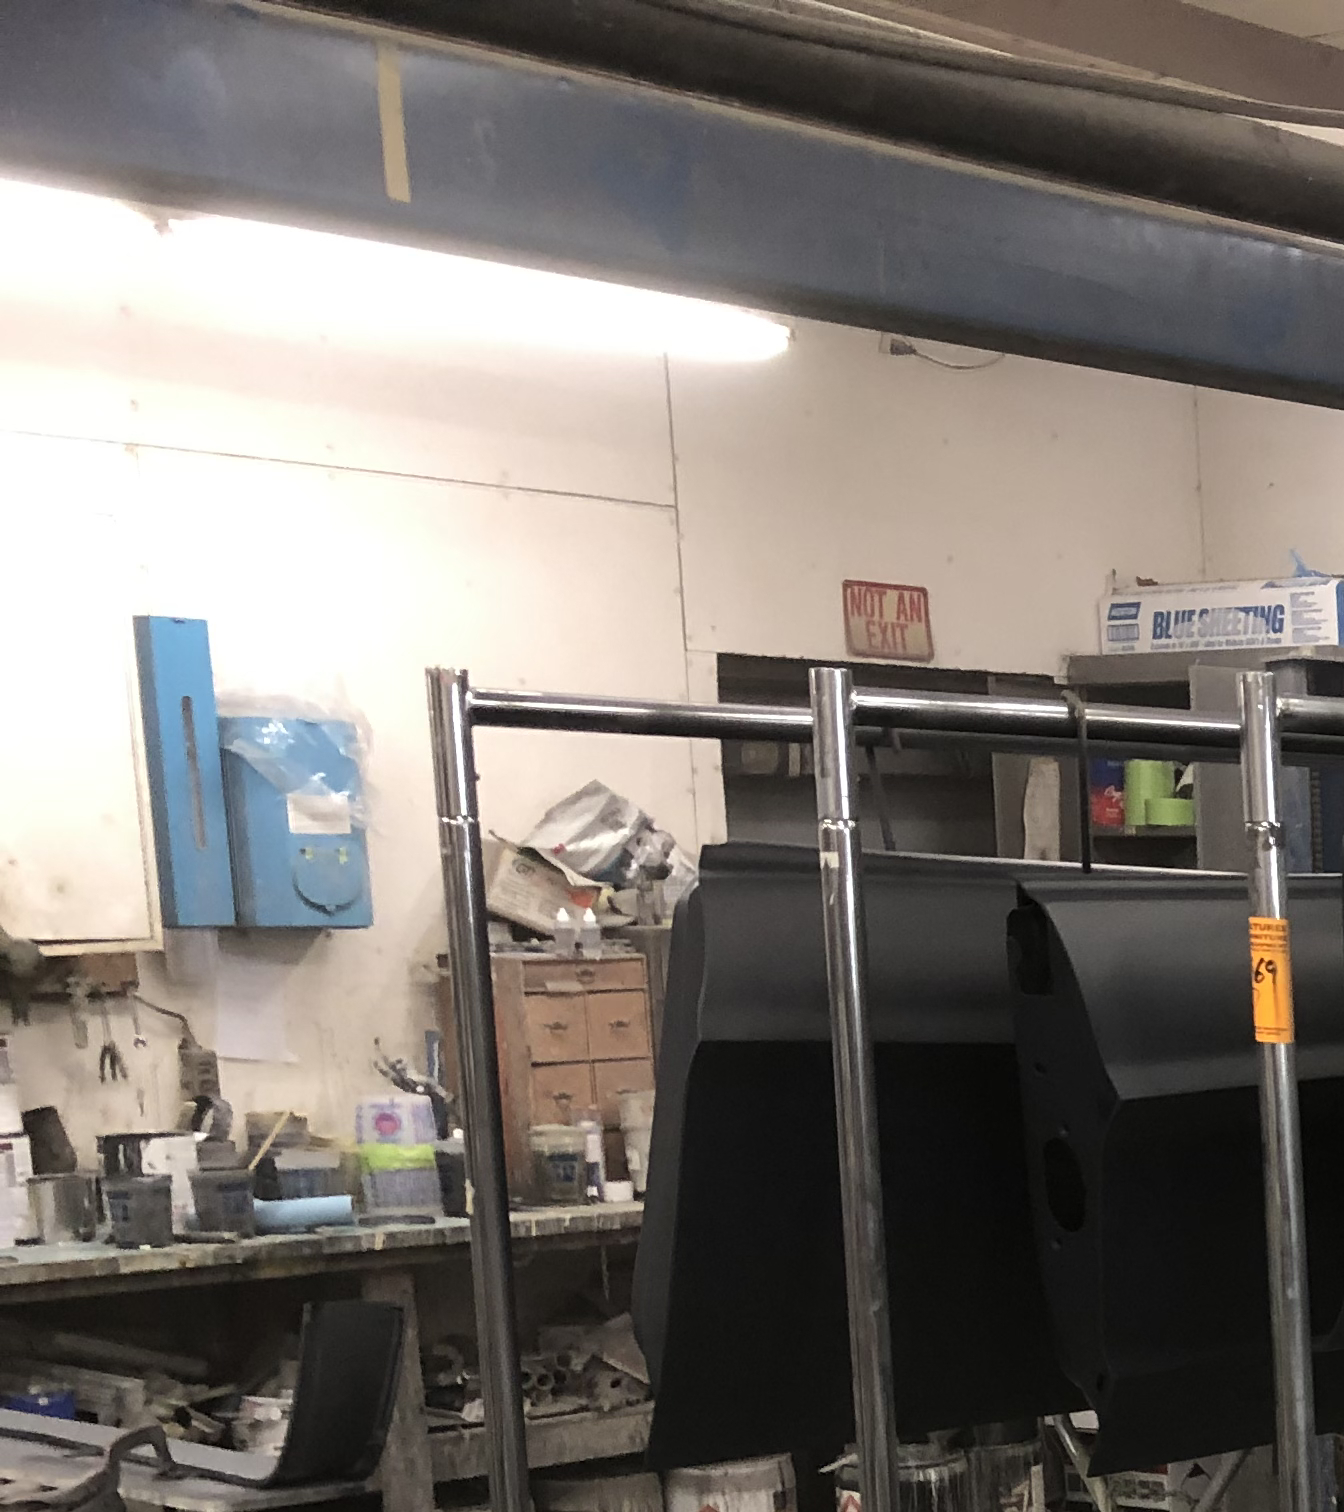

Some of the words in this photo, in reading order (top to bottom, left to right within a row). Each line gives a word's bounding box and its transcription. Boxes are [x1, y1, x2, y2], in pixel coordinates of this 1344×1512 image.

[850, 586, 887, 617] NOT
[897, 591, 922, 623] AN
[866, 620, 908, 652] EXIT
[1152, 609, 1196, 640] BLUE
[1198, 604, 1285, 637] SHEETING
[1255, 958, 1277, 985] 69
